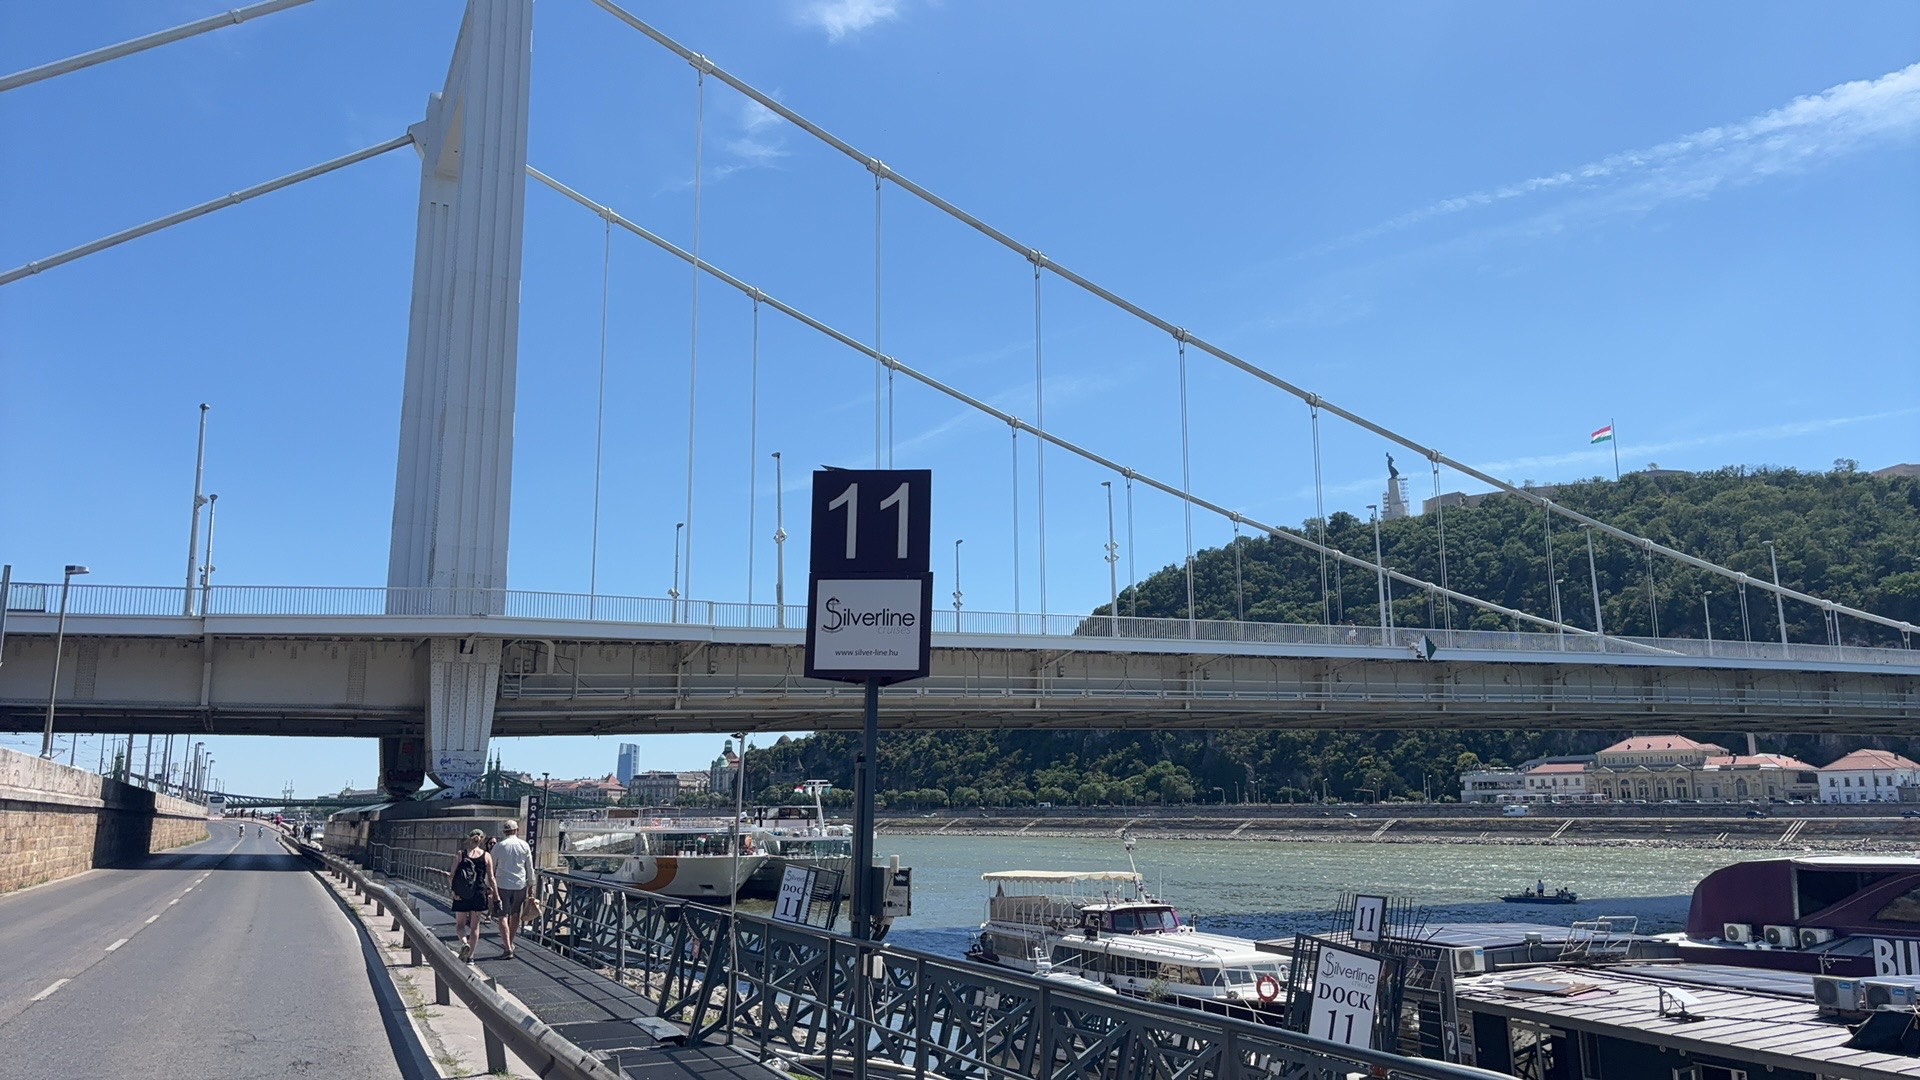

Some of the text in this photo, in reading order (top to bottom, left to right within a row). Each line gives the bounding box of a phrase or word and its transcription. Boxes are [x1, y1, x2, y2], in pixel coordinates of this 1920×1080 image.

[828, 482, 910, 560] 11
[821, 597, 915, 633] Silverline
[877, 626, 911, 635] cruises
[834, 649, 899, 657] www.silver-line.hu
[529, 797, 537, 827] BOAT
[1357, 906, 1376, 933] 11
[1321, 951, 1375, 985] Silverline
[1873, 938, 1920, 976] BU
[1317, 981, 1372, 1011] DOCK
[1327, 1009, 1354, 1045] 11
[1443, 1020, 1456, 1029] GATE
[1447, 1030, 1456, 1055] 2
